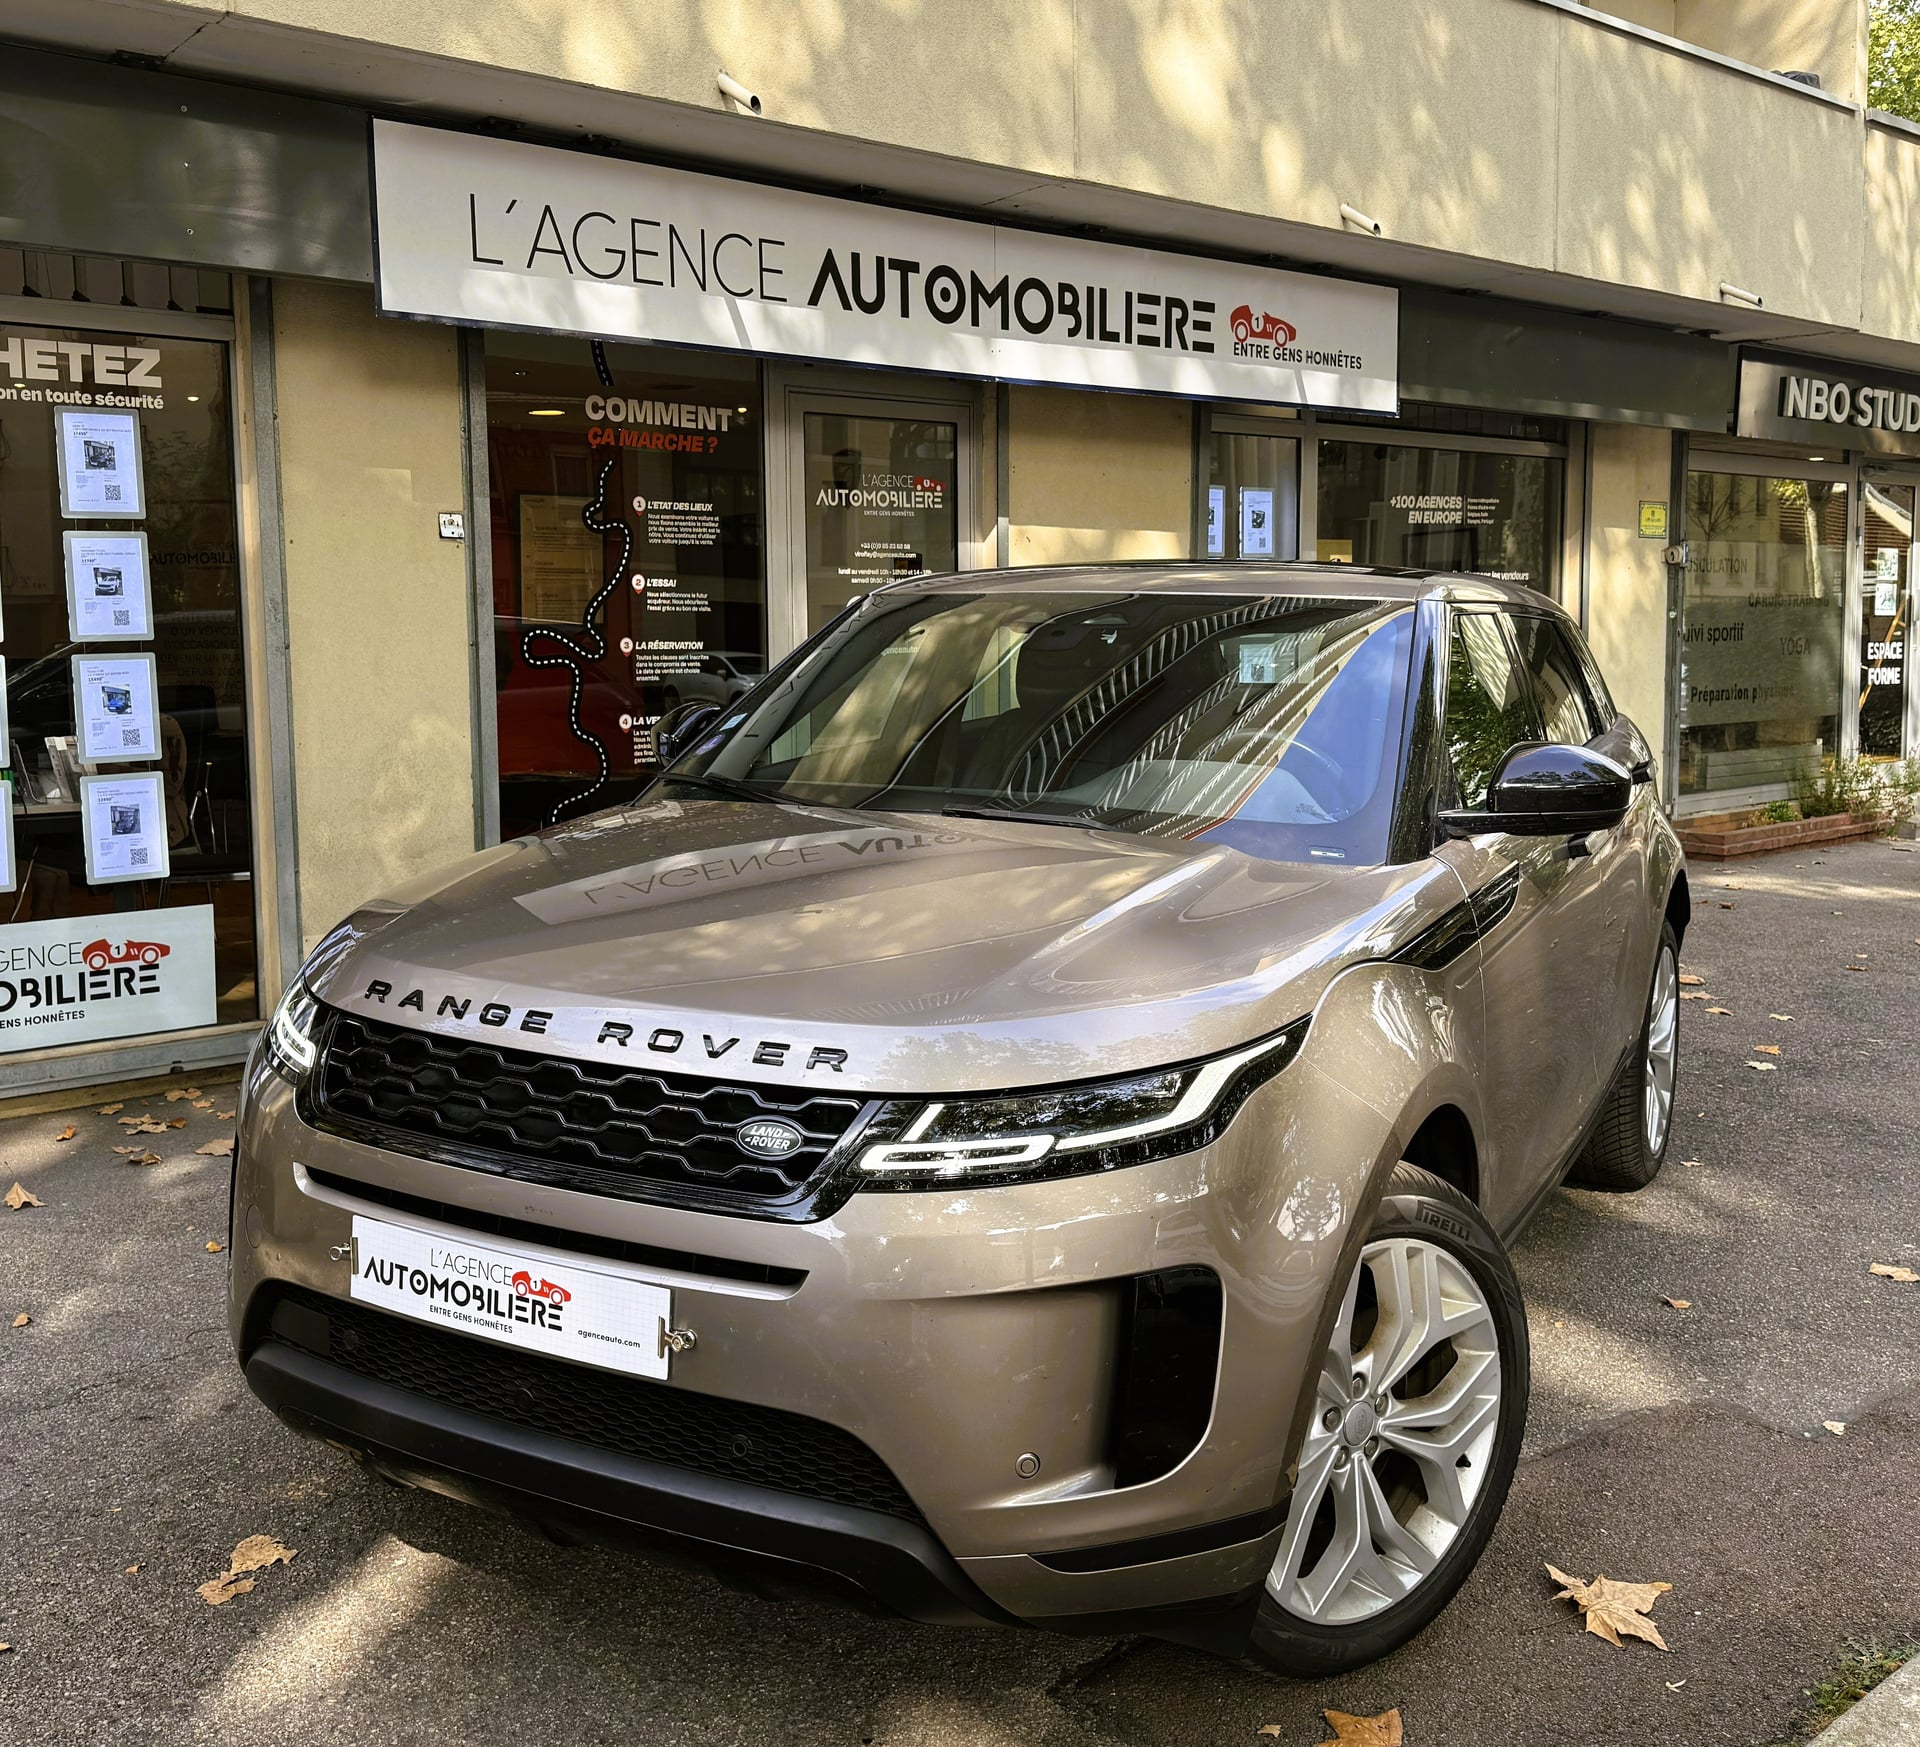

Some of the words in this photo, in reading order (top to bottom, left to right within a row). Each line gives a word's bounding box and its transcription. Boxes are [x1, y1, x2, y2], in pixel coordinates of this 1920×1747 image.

[470, 193, 787, 303] L'AGENCE
[806, 247, 1216, 354] AUTOMOBILIERE
[1233, 341, 1270, 359] ENTRE
[1273, 347, 1303, 363] GENS
[1305, 350, 1362, 370] HONNÊTES
[20, 389, 42, 402] en
[45, 388, 92, 405] toute
[95, 391, 164, 409] sécurité
[1786, 376, 1850, 425] NBO
[585, 394, 732, 432] COMMENT
[588, 426, 615, 449] ÇA
[619, 429, 703, 453] MARCHE
[707, 436, 718, 454] ?
[862, 473, 914, 488] L'AGENCE
[647, 501, 672, 510] L'ETAT
[673, 502, 689, 511] DES
[690, 503, 713, 512] LIEUX
[815, 488, 943, 509] AUTOMOBILIERE
[1390, 495, 1415, 508] +100
[1415, 496, 1462, 509] AGENCES
[1407, 511, 1422, 524] EN
[1423, 512, 1462, 524] EUROPE
[647, 578, 677, 588] L'ESSAI
[1501, 571, 1529, 581] vendeurs
[1707, 621, 1745, 646] sportif
[636, 641, 646, 650] LA
[648, 639, 704, 650] RÉSERVATION
[1779, 633, 1811, 656] YOGA
[1867, 641, 1903, 660] ESPACE
[1867, 666, 1901, 685] FORME
[1690, 683, 1749, 707] Préparation
[633, 716, 644, 726] LA
[24, 1009, 86, 1026] HONNÊTES
[364, 979, 554, 1035] RANGE
[596, 1020, 849, 1074] ROVER
[750, 1126, 784, 1138] LAND
[750, 1135, 791, 1151] ROVER
[1414, 1199, 1471, 1242] PIRELLI
[430, 1248, 513, 1290] L'AGENCE
[363, 1255, 563, 1332] AUTOMOBILIERE
[429, 1304, 452, 1318] ENTRE
[453, 1311, 473, 1324] GENS
[473, 1316, 513, 1334] HONNÊTES
[578, 1329, 641, 1349] agenceauto.com
